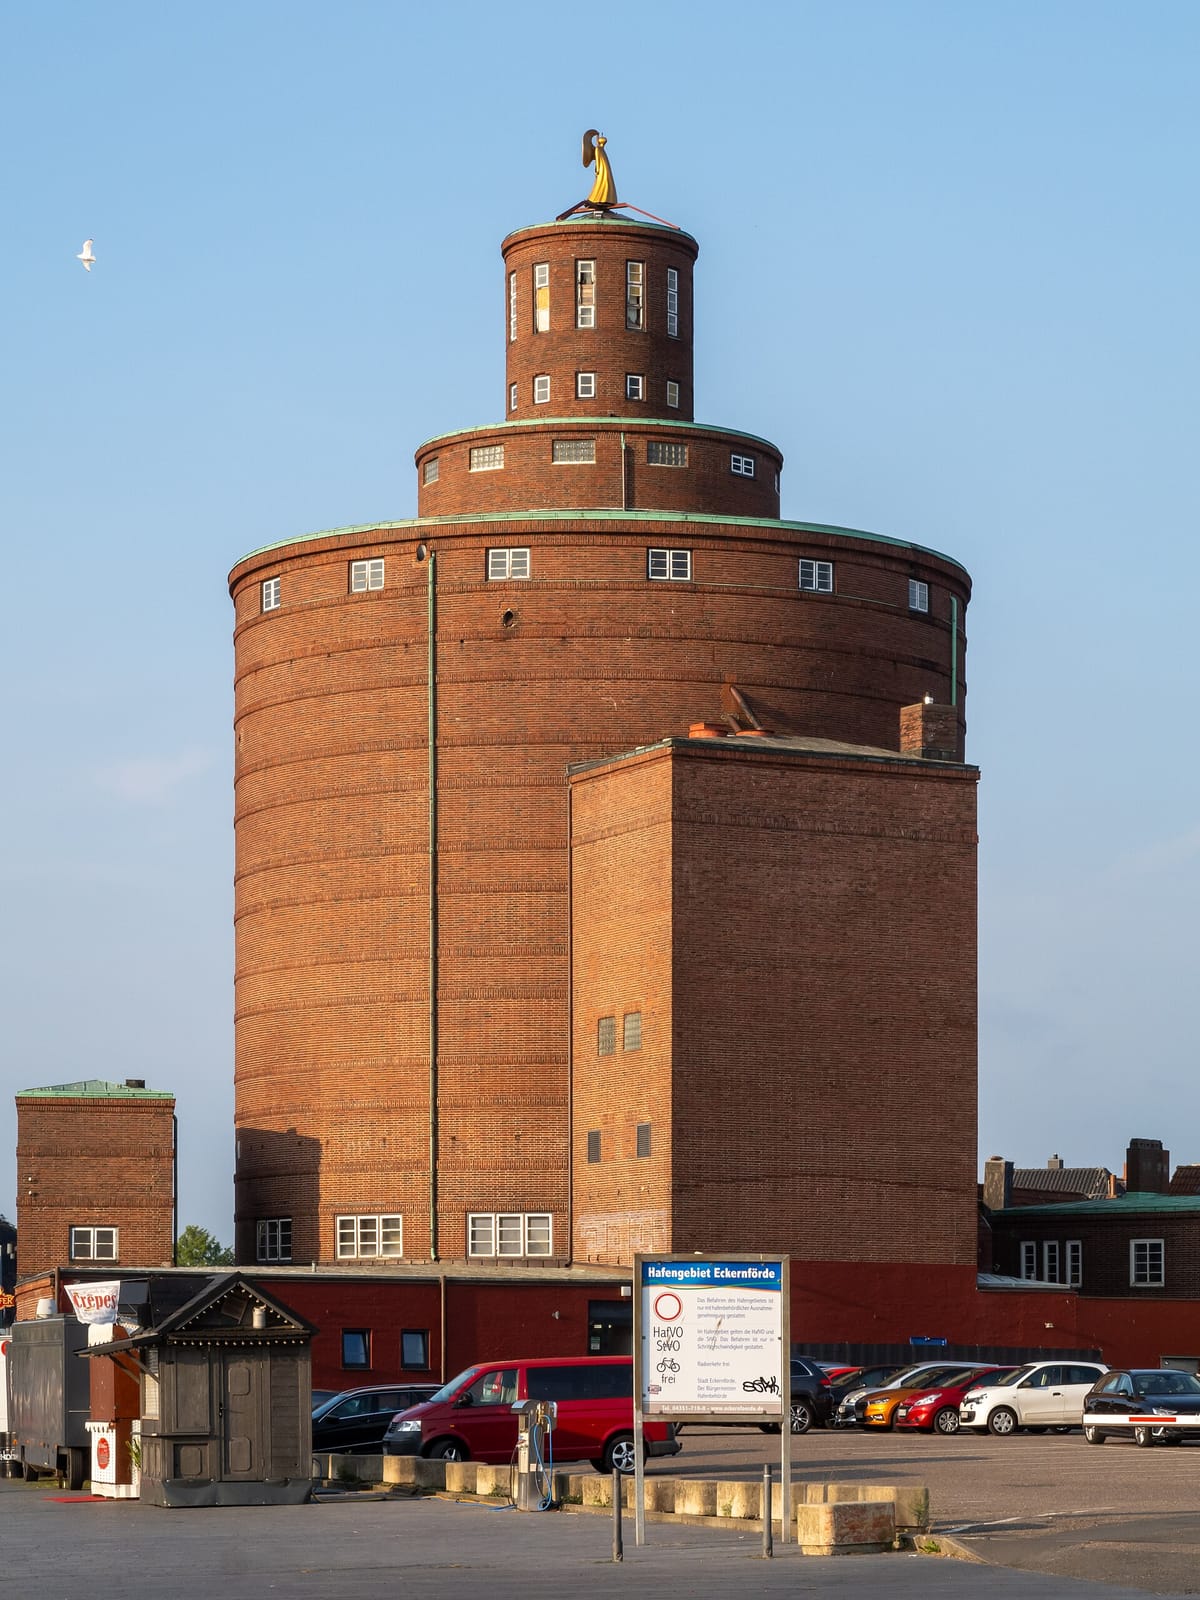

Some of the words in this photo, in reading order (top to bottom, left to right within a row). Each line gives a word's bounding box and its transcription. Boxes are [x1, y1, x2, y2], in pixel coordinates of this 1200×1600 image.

[648, 1267, 711, 1280] Hafengebiet
[714, 1267, 775, 1279] Eckernförde
[72, 1292, 117, 1310] Crêpes
[653, 1326, 684, 1338] HafVO
[656, 1340, 681, 1352] StVO
[661, 1373, 676, 1384] frei
